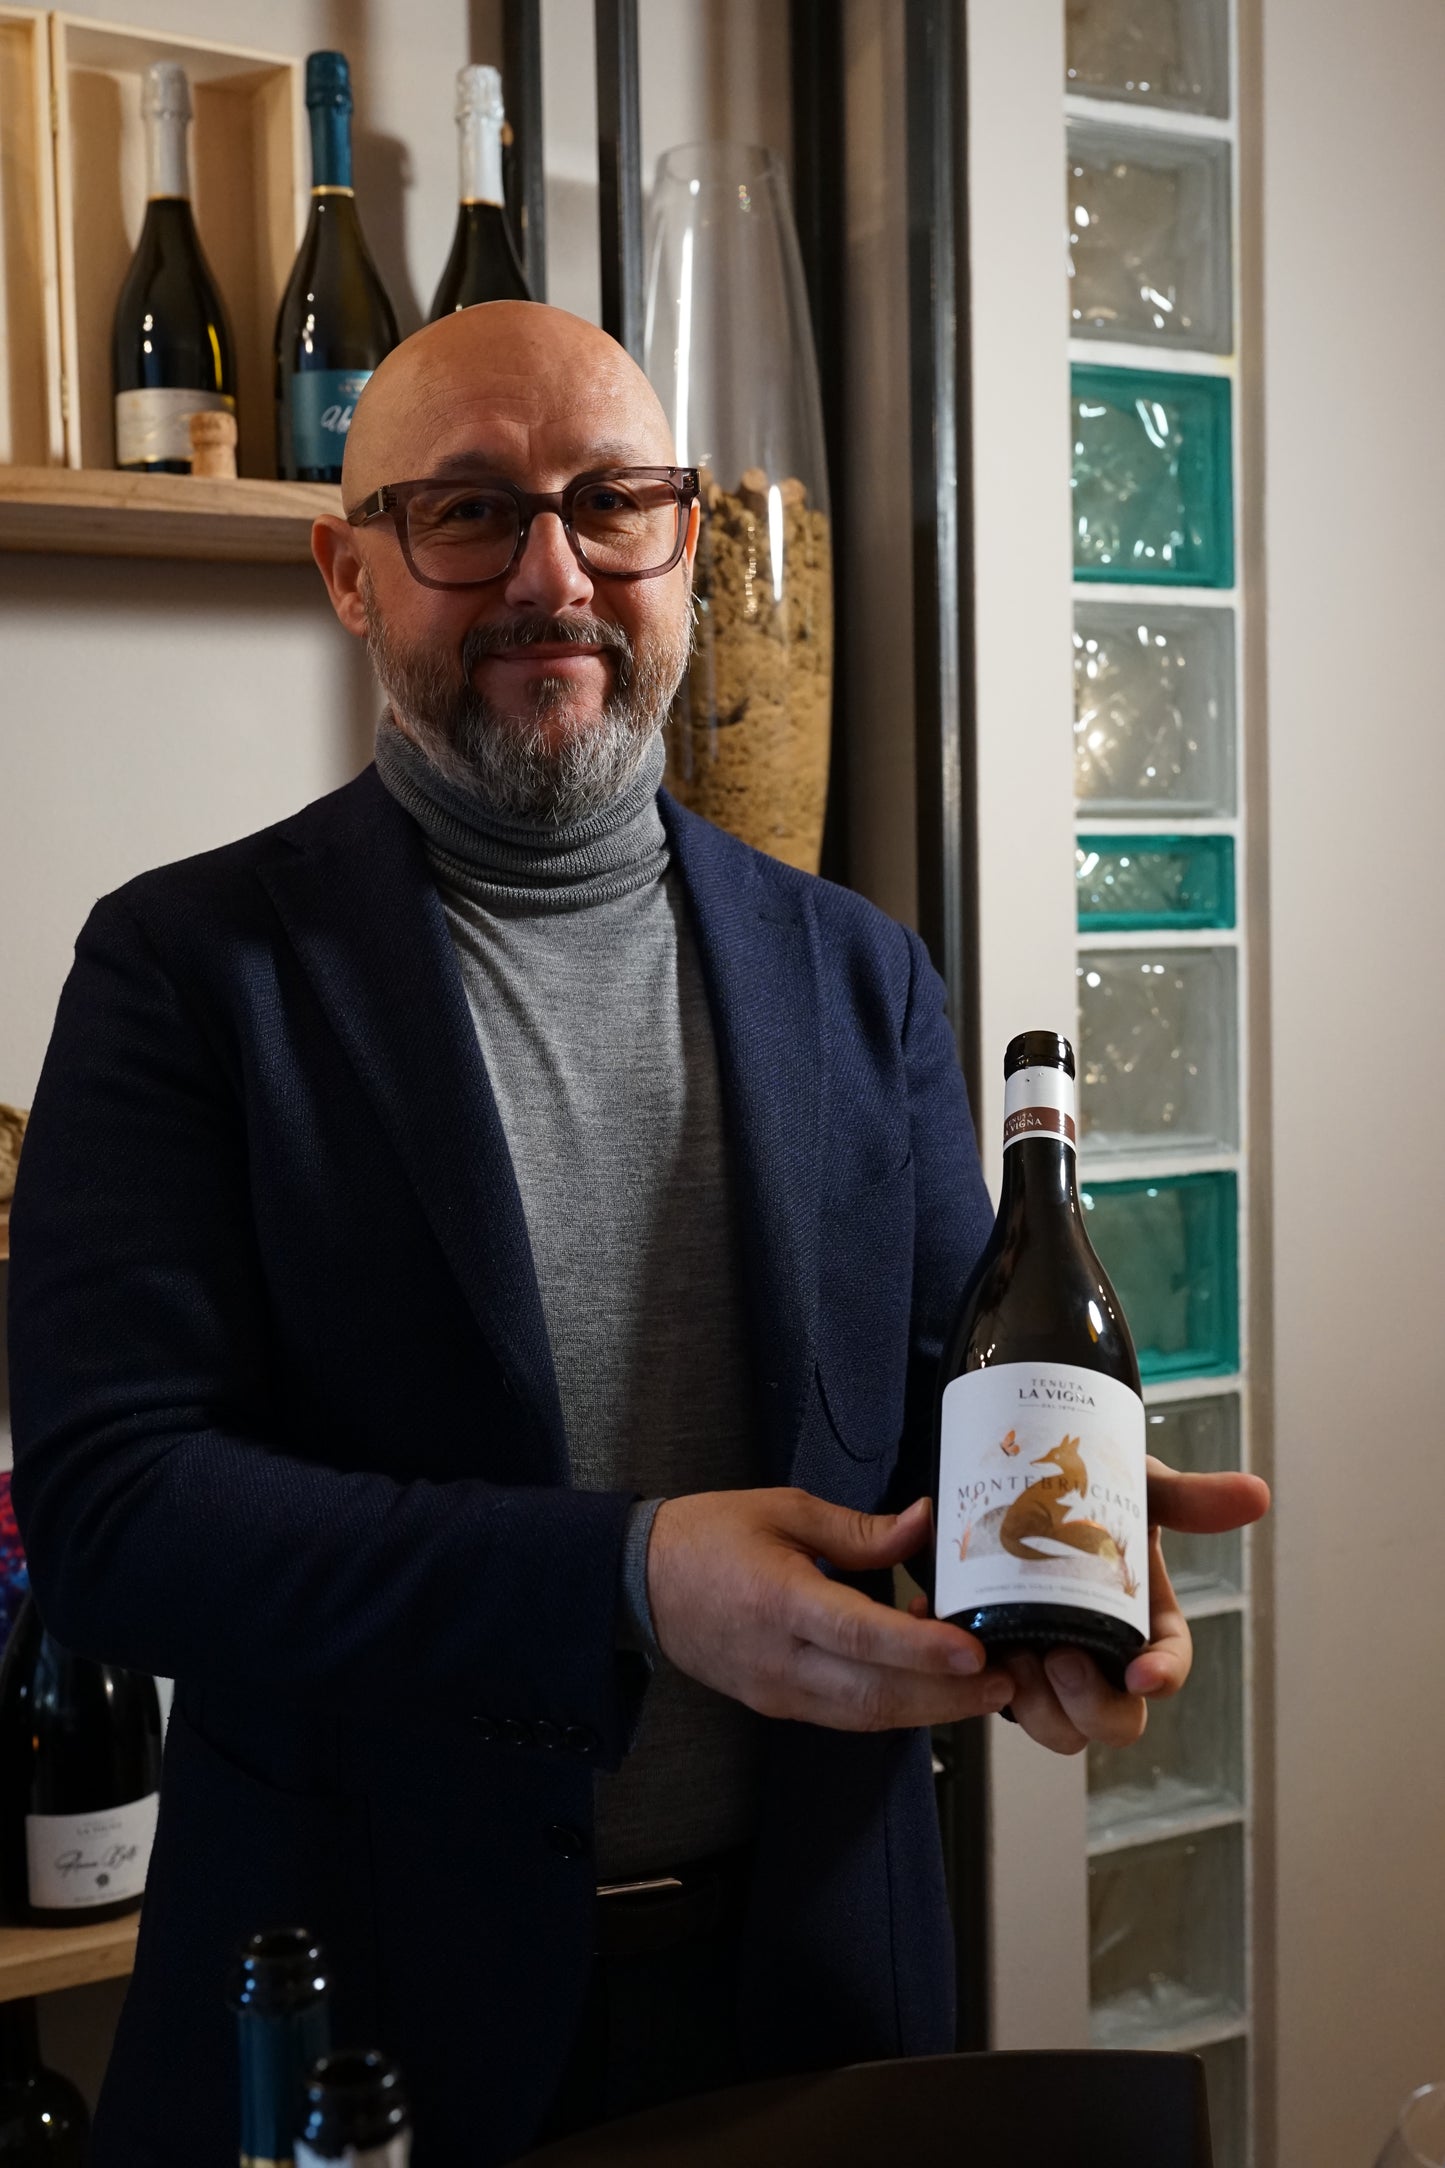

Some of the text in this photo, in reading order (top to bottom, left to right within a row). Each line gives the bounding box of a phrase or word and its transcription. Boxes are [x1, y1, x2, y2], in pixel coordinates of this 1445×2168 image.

[1010, 1118, 1042, 1132] VIGNA
[1031, 1379, 1083, 1391] TENUTA
[1019, 1388, 1095, 1407] LA VIGNA
